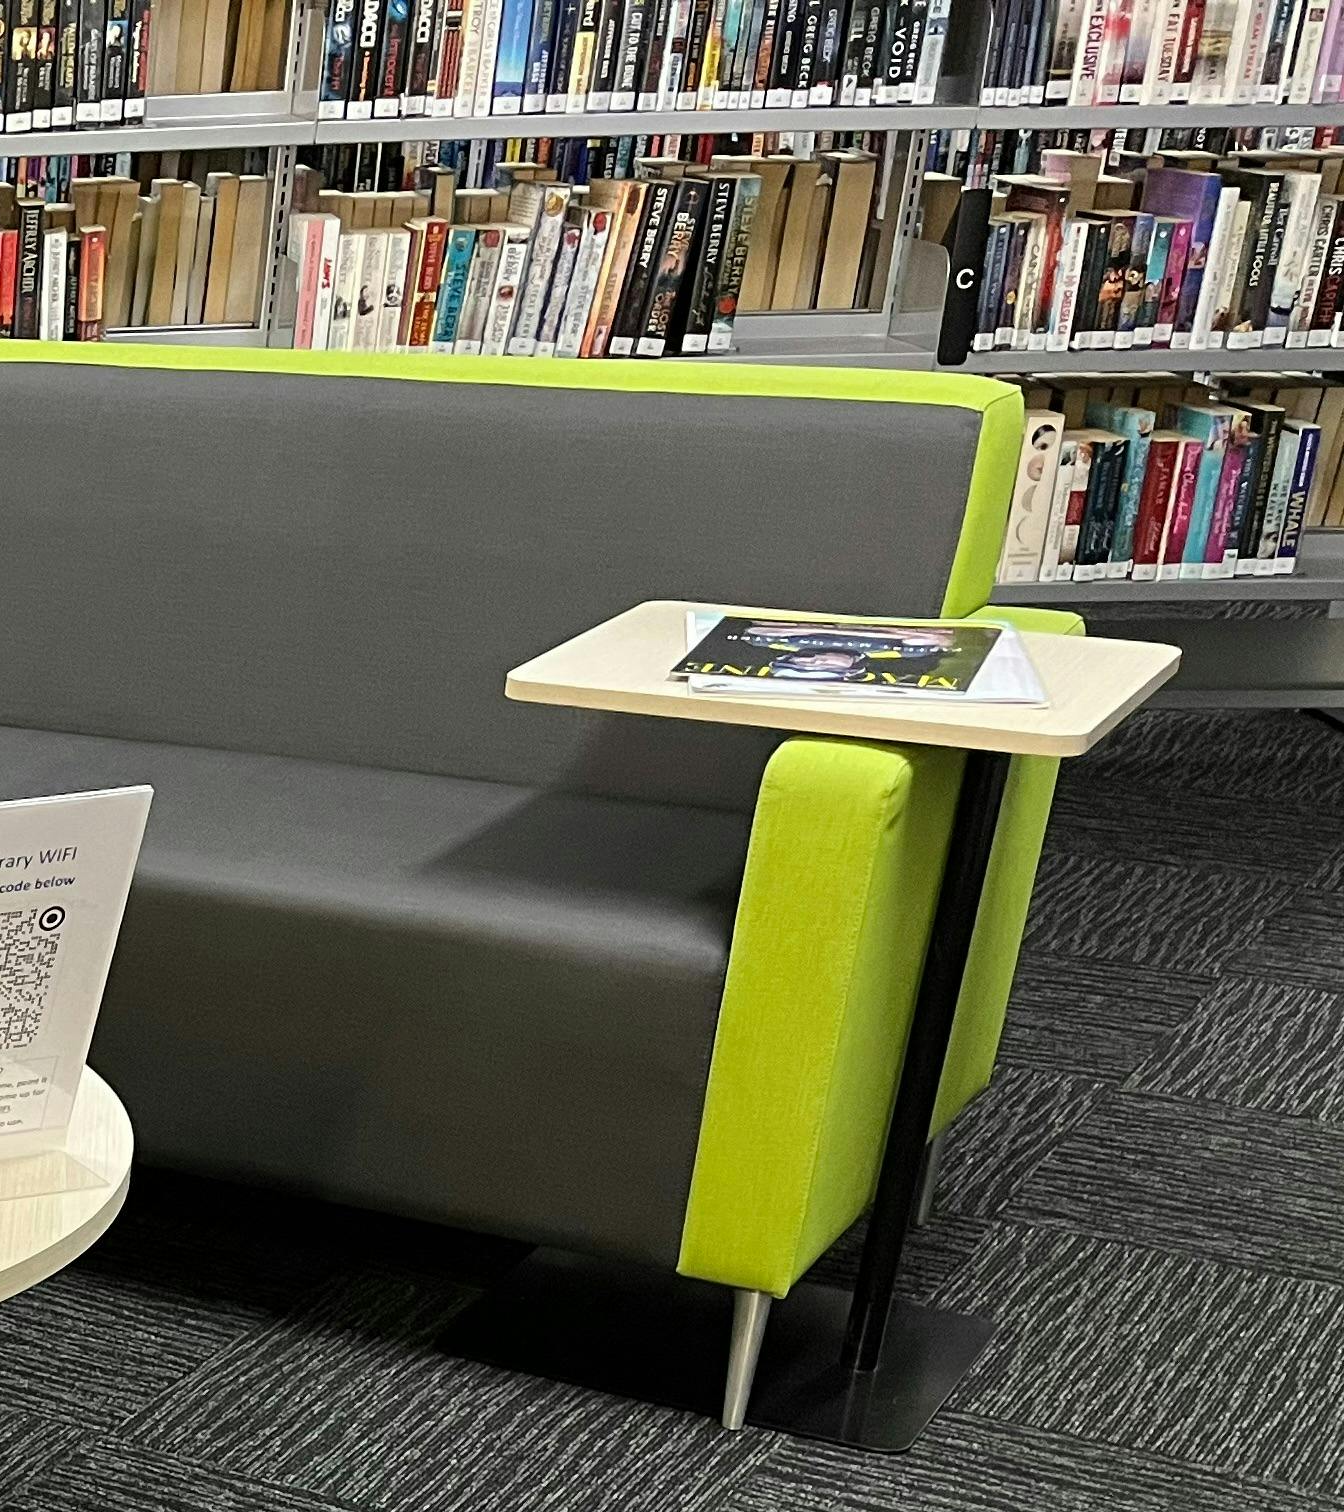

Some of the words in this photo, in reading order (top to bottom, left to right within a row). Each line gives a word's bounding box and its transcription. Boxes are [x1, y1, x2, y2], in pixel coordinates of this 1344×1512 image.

[470, 3, 483, 34] TROY
[630, 13, 642, 30] CUT
[803, 16, 818, 53] GREIG
[826, 9, 838, 37] GREIG
[866, 8, 880, 43] GREIG
[910, 21, 920, 50] GREIG
[1166, 14, 1180, 32] FAT
[626, 47, 638, 62] THE
[628, 33, 640, 45] TO
[822, 39, 834, 62] BECK
[889, 27, 907, 79] VOID
[1080, 15, 1104, 80] EXCLUSIVE
[384, 39, 401, 95] Innocent
[798, 58, 813, 88] BECK
[861, 47, 874, 78] BECK
[905, 52, 915, 76] BECK
[1158, 37, 1177, 82] TUESDAY
[650, 187, 667, 226] STEVE
[712, 182, 730, 221] STEVE
[23, 209, 39, 250] JEFFREY
[667, 212, 689, 256] BERRY
[681, 217, 696, 249] STEVE
[741, 196, 756, 243] STEVE
[1317, 205, 1334, 236] CHRIS
[639, 229, 660, 268] BERRY
[705, 224, 723, 264] BERRY
[1308, 238, 1327, 277] CARTER
[503, 247, 516, 282] BERRY
[729, 246, 749, 295] BERRY
[956, 269, 975, 289] C
[1249, 255, 1265, 287] FOOLS
[449, 264, 466, 302] STEVE
[441, 306, 460, 342] BERRY
[647, 293, 664, 332] ORDER
[655, 309, 672, 337] LOST
[1282, 491, 1306, 548] WHALE
[40, 847, 77, 864] WIFI
[0, 881, 31, 894] code
[35, 876, 75, 889] below
[20, 1091, 30, 1099] up
[32, 1088, 45, 1096] for
